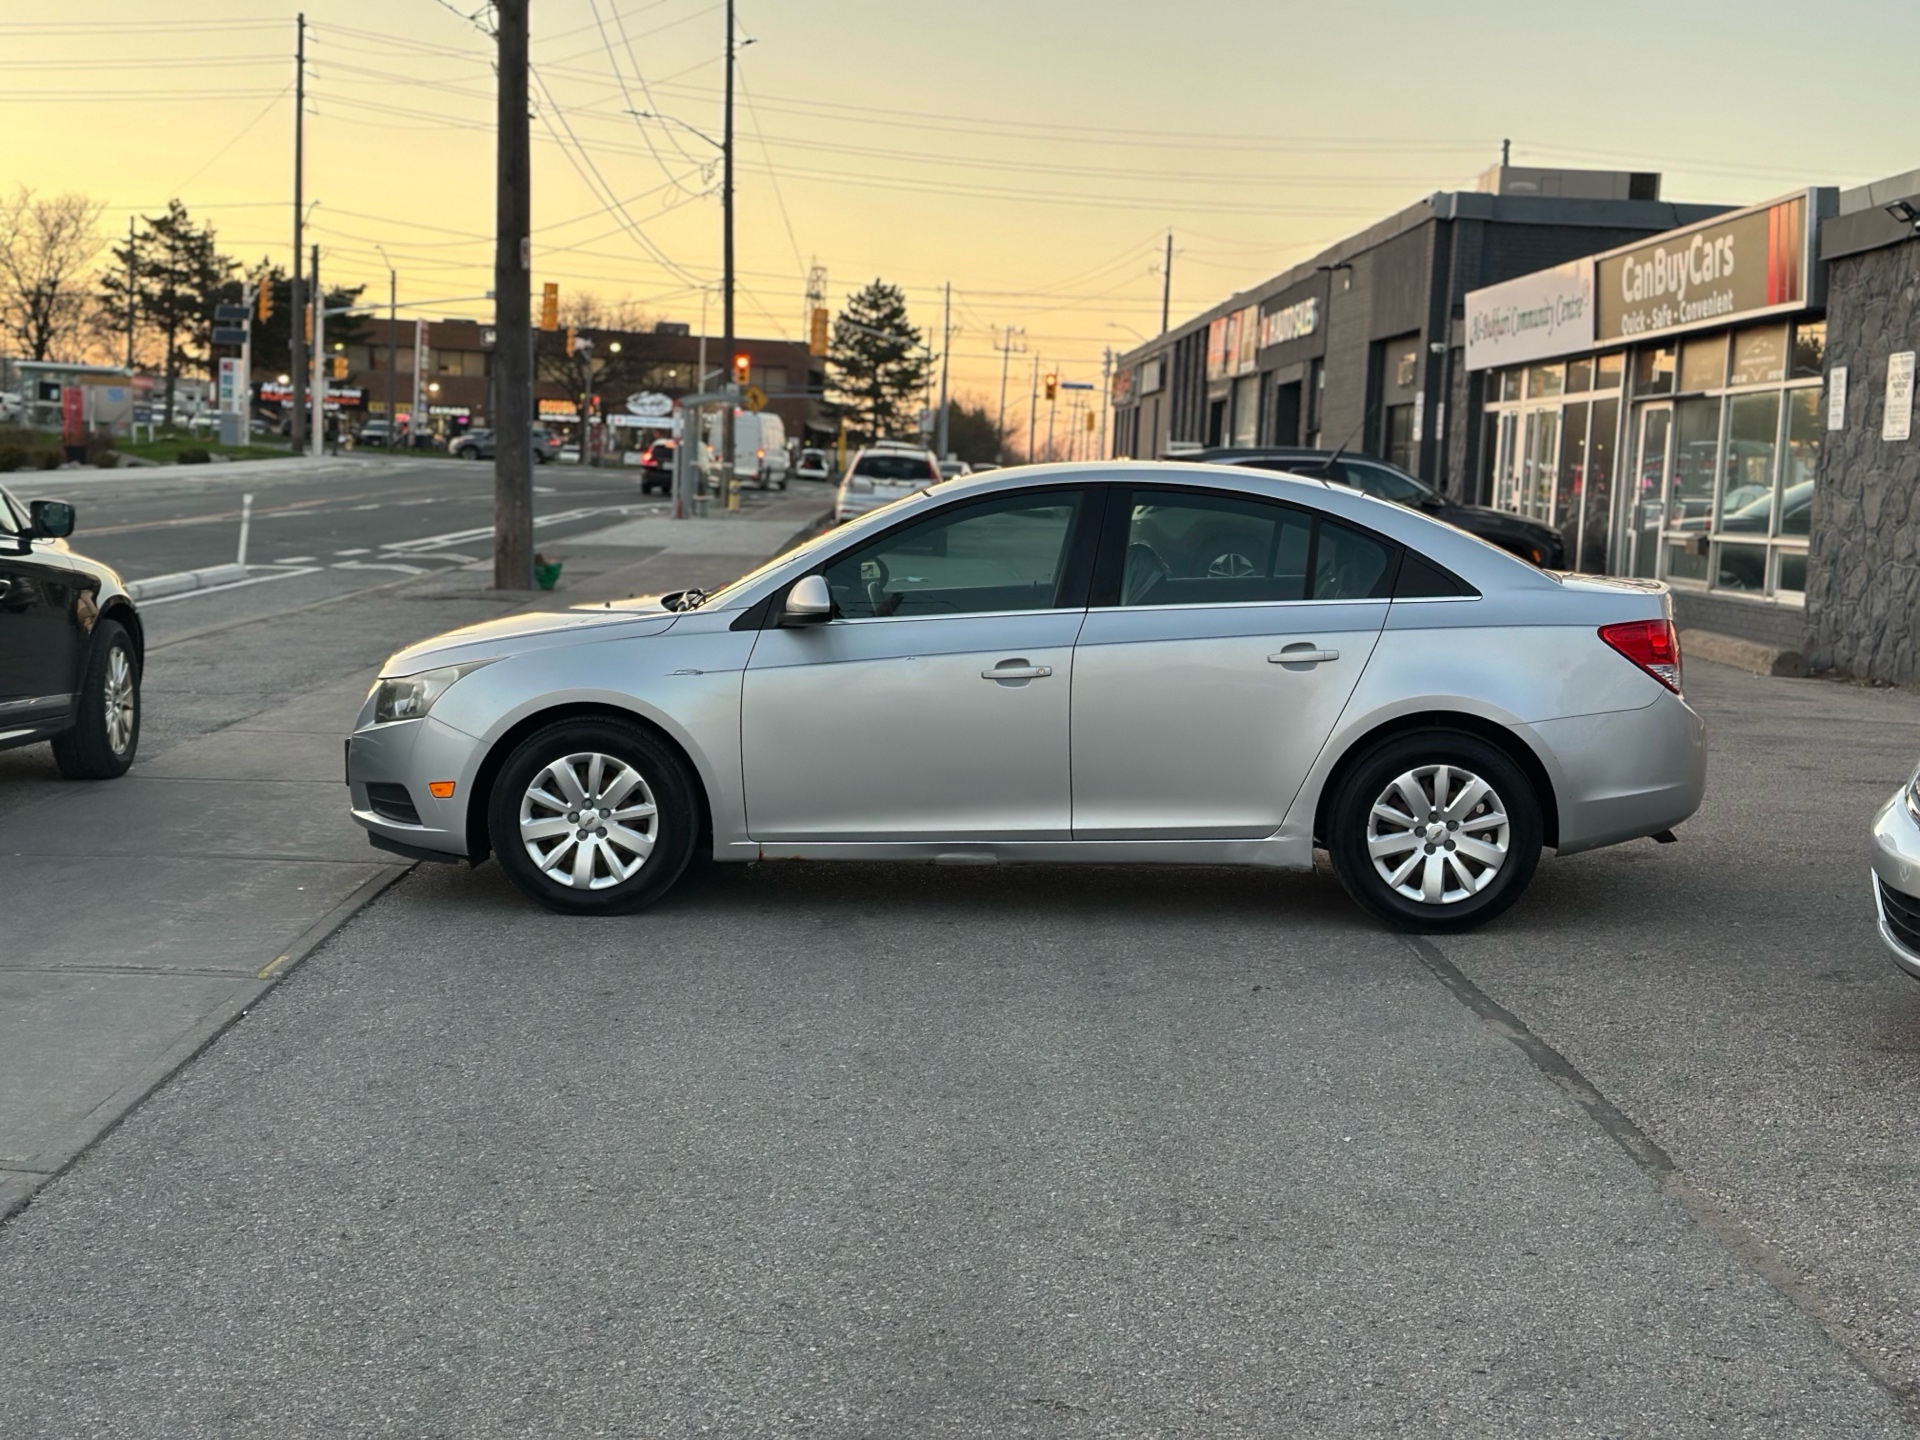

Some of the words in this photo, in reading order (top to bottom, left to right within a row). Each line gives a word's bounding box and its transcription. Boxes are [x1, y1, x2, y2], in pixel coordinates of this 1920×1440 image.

[1622, 234, 1734, 303] CanBuyCars
[1622, 309, 1645, 336] Quick
[1652, 303, 1672, 329] Safe
[1680, 289, 1733, 323] Convenient
